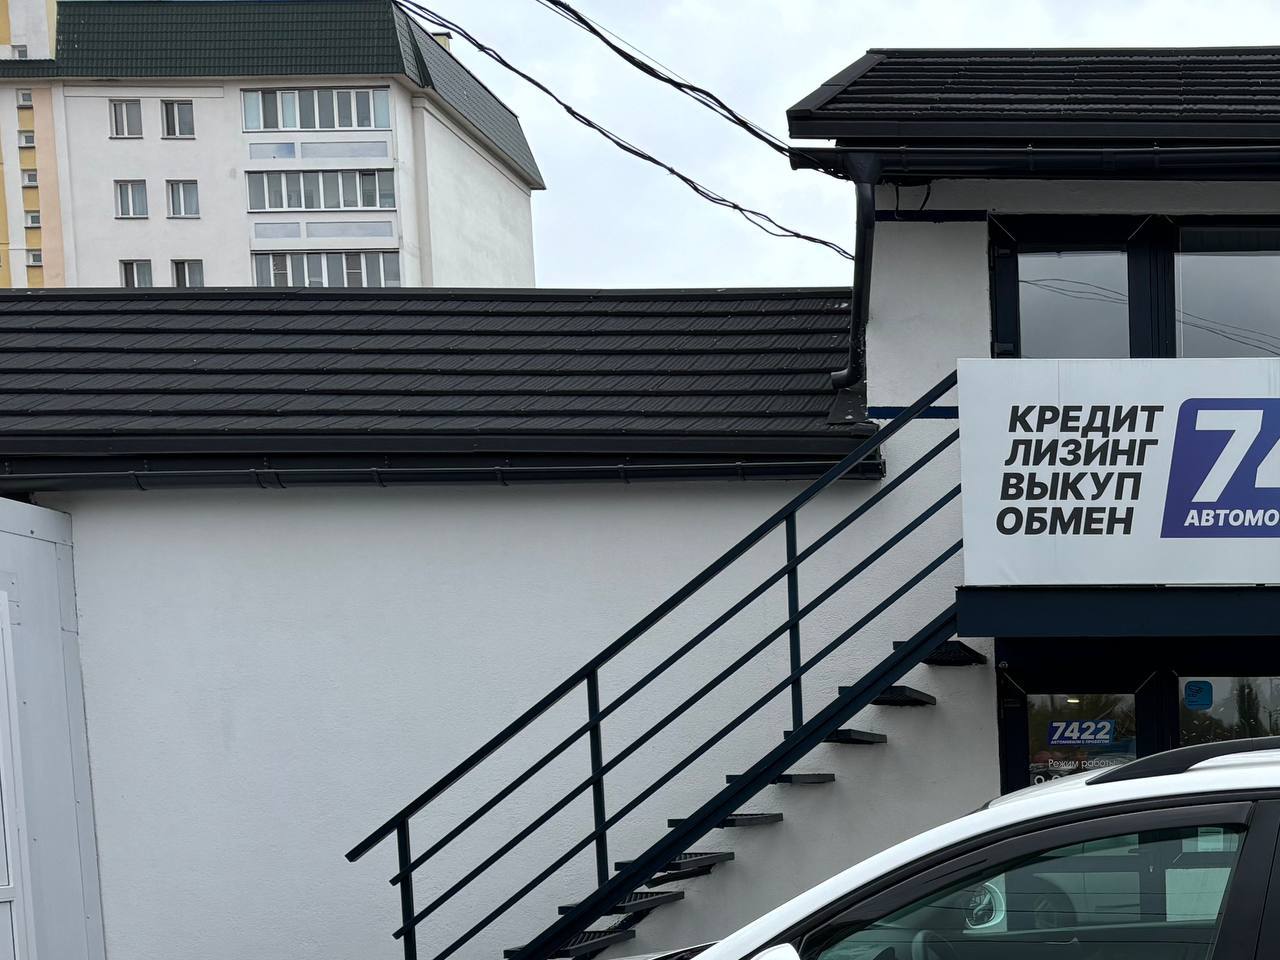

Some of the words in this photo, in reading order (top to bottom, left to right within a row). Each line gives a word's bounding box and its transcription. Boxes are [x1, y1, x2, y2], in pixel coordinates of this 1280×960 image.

[1009, 406, 1164, 438] КРЕДИТ
[1005, 439, 1158, 466] ЛИЗИНГ
[1000, 472, 1142, 500] ВЫКУП
[996, 507, 1134, 535] ОБМЕН
[1052, 722, 1111, 740] 7422
[1048, 759, 1079, 768] Режим
